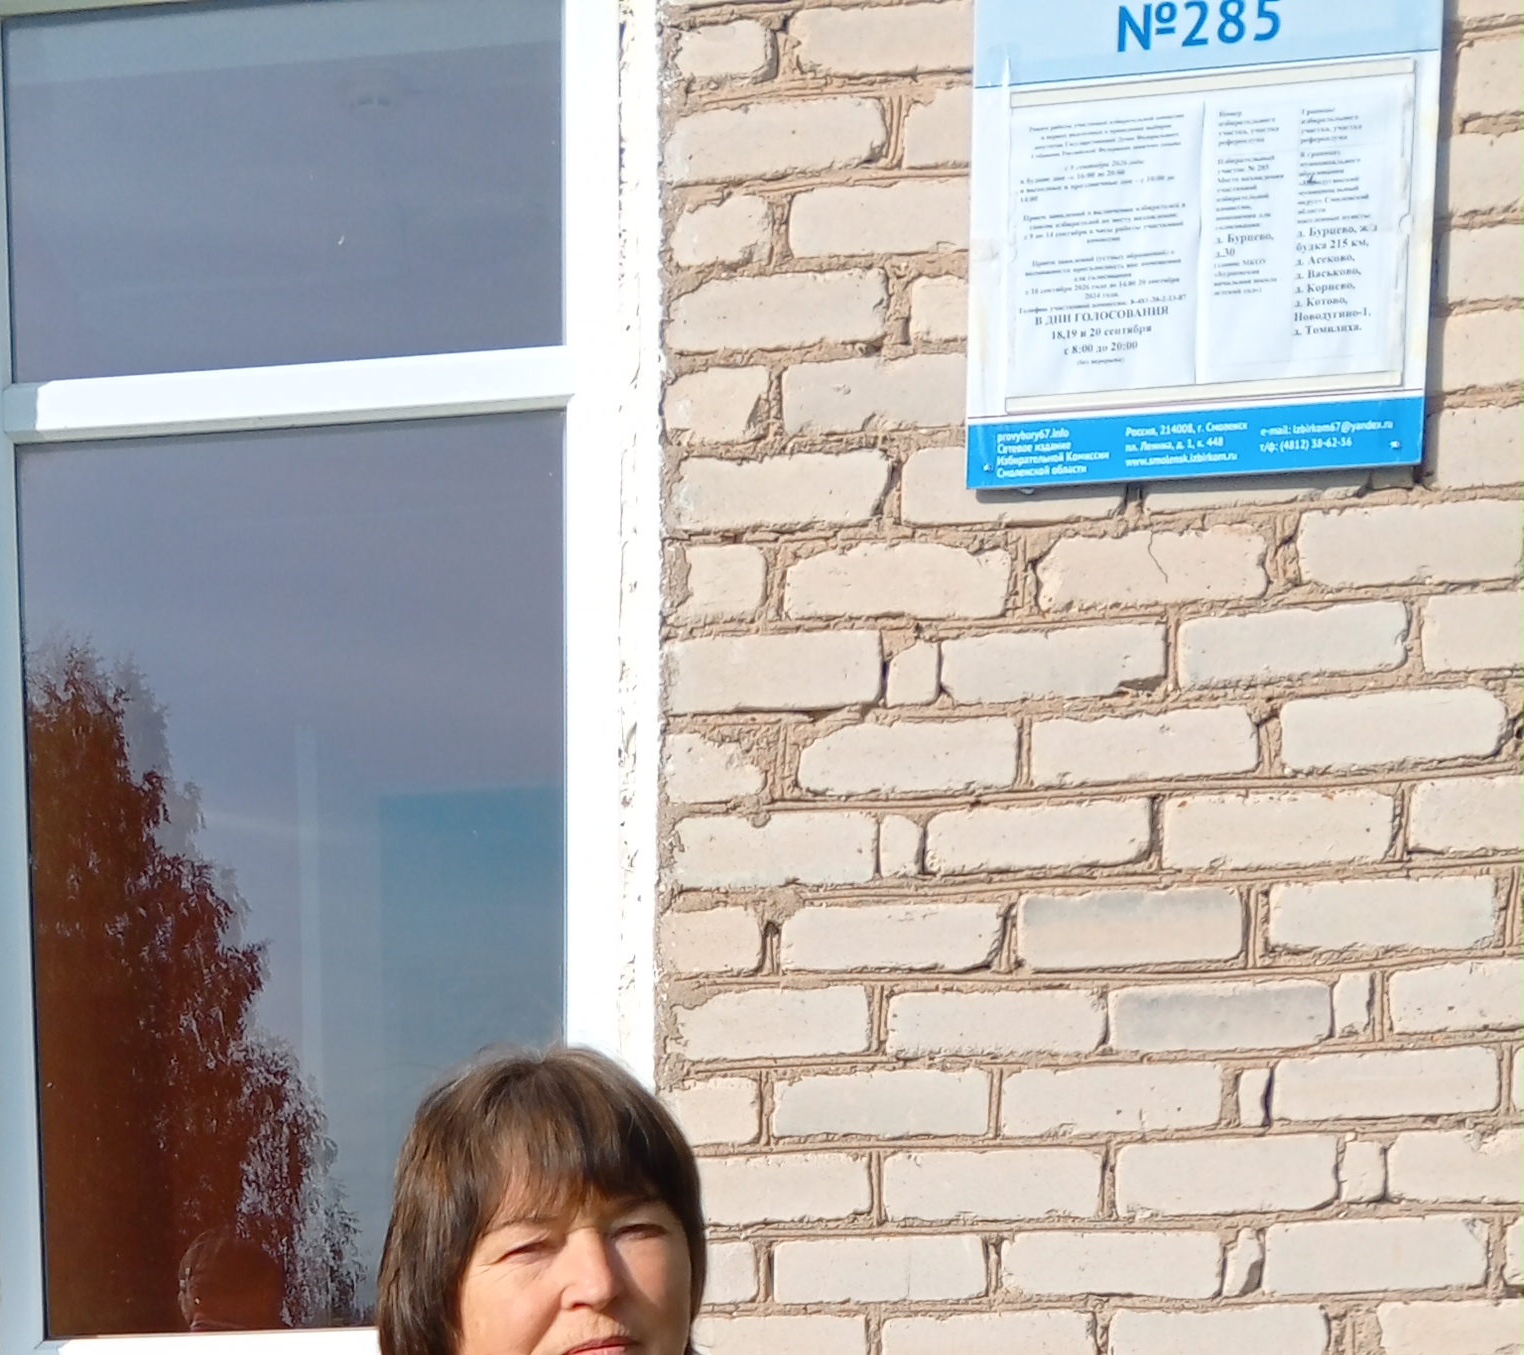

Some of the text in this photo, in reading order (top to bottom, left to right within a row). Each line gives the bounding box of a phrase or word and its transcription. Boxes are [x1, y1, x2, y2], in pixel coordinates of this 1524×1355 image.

[1309, 226, 1357, 237] Бурцево,
[1296, 242, 1327, 254] будка
[1330, 238, 1348, 248] 215
[1308, 268, 1361, 279] Васьково,
[1307, 297, 1348, 307] Котово,
[1035, 305, 1169, 325] В ДНИ ГОЛОСОВАНИЯ
[1052, 330, 1077, 341] 18,19
[1089, 328, 1101, 337] 20
[1104, 325, 1152, 336] сентября
[1072, 344, 1093, 354] 8:00
[1096, 345, 1108, 353] до
[1110, 341, 1138, 351] 20:00
[1260, 425, 1291, 436] e-mail:
